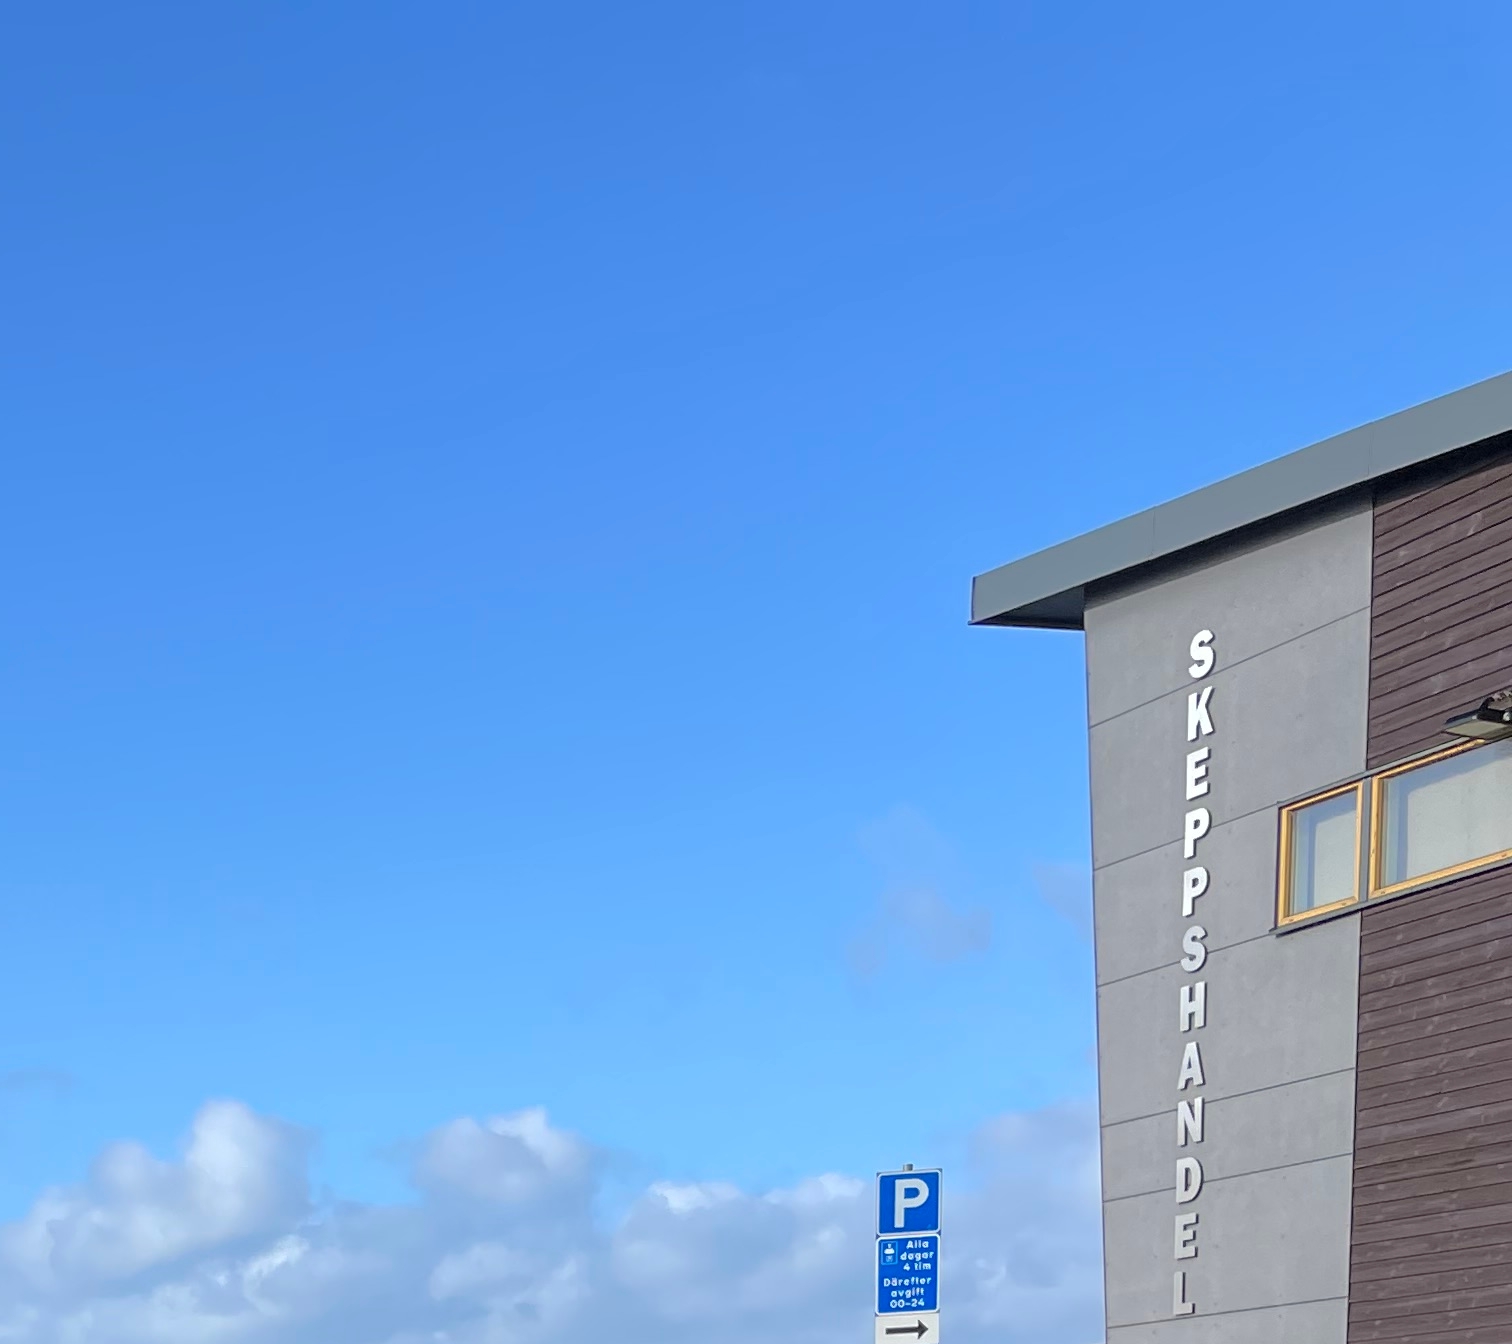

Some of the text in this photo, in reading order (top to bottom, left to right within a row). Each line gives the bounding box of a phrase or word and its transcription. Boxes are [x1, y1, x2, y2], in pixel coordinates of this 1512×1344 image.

[1172, 629, 1214, 1315] SKEPPSHANDEL
[894, 1178, 929, 1228] P
[906, 1240, 929, 1249] Alla
[900, 1250, 934, 1261] dagar
[903, 1261, 931, 1271] 4 tim
[884, 1277, 931, 1287] Därefter
[891, 1288, 925, 1299] avgift
[890, 1299, 925, 1309] 00-24
